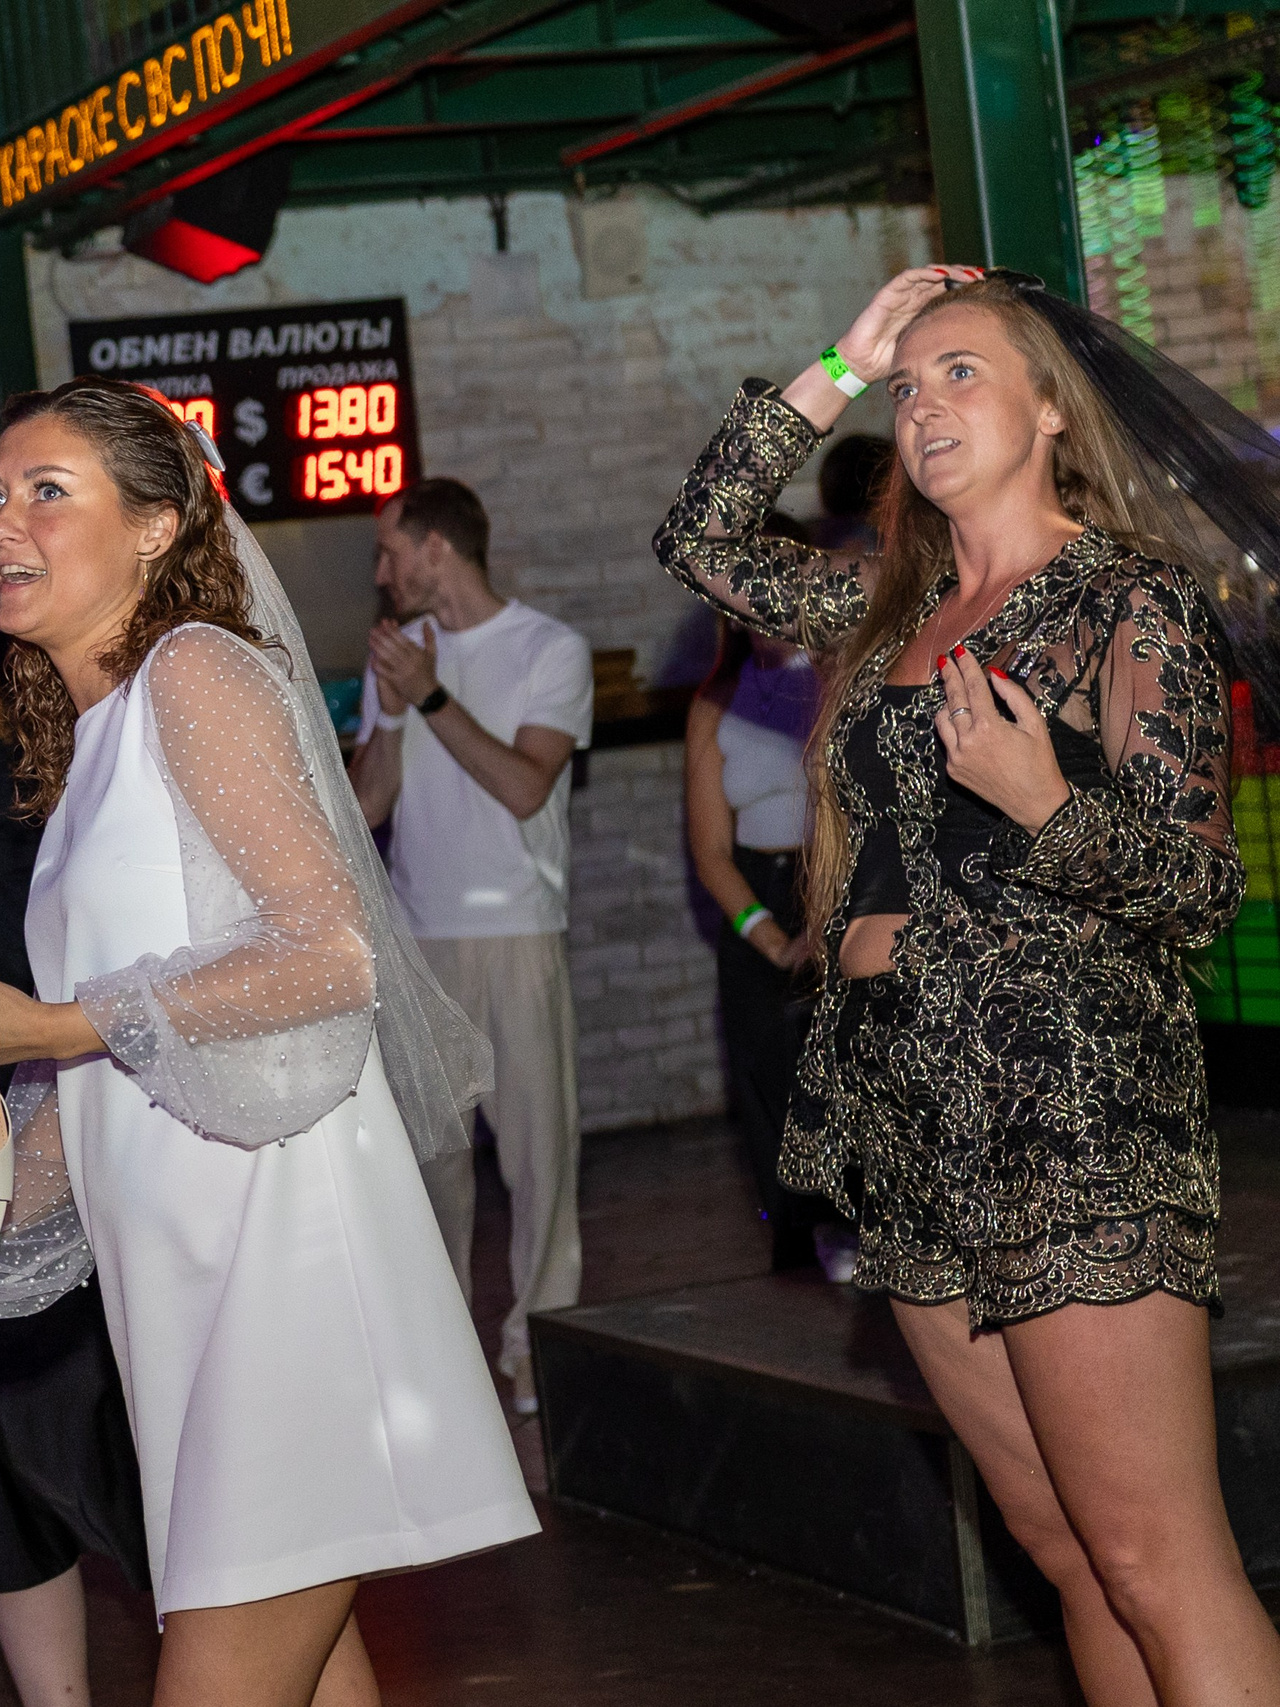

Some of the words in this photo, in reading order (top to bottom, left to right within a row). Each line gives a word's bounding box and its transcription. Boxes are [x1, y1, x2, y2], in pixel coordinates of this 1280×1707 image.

[116, 70, 147, 140] С
[143, 43, 192, 127] ВС
[191, 13, 244, 102] ПО
[89, 329, 219, 371] ОБМЕН
[227, 317, 393, 360] ВАЛЮТЫ
[276, 358, 399, 389] ПРОДАЖА
